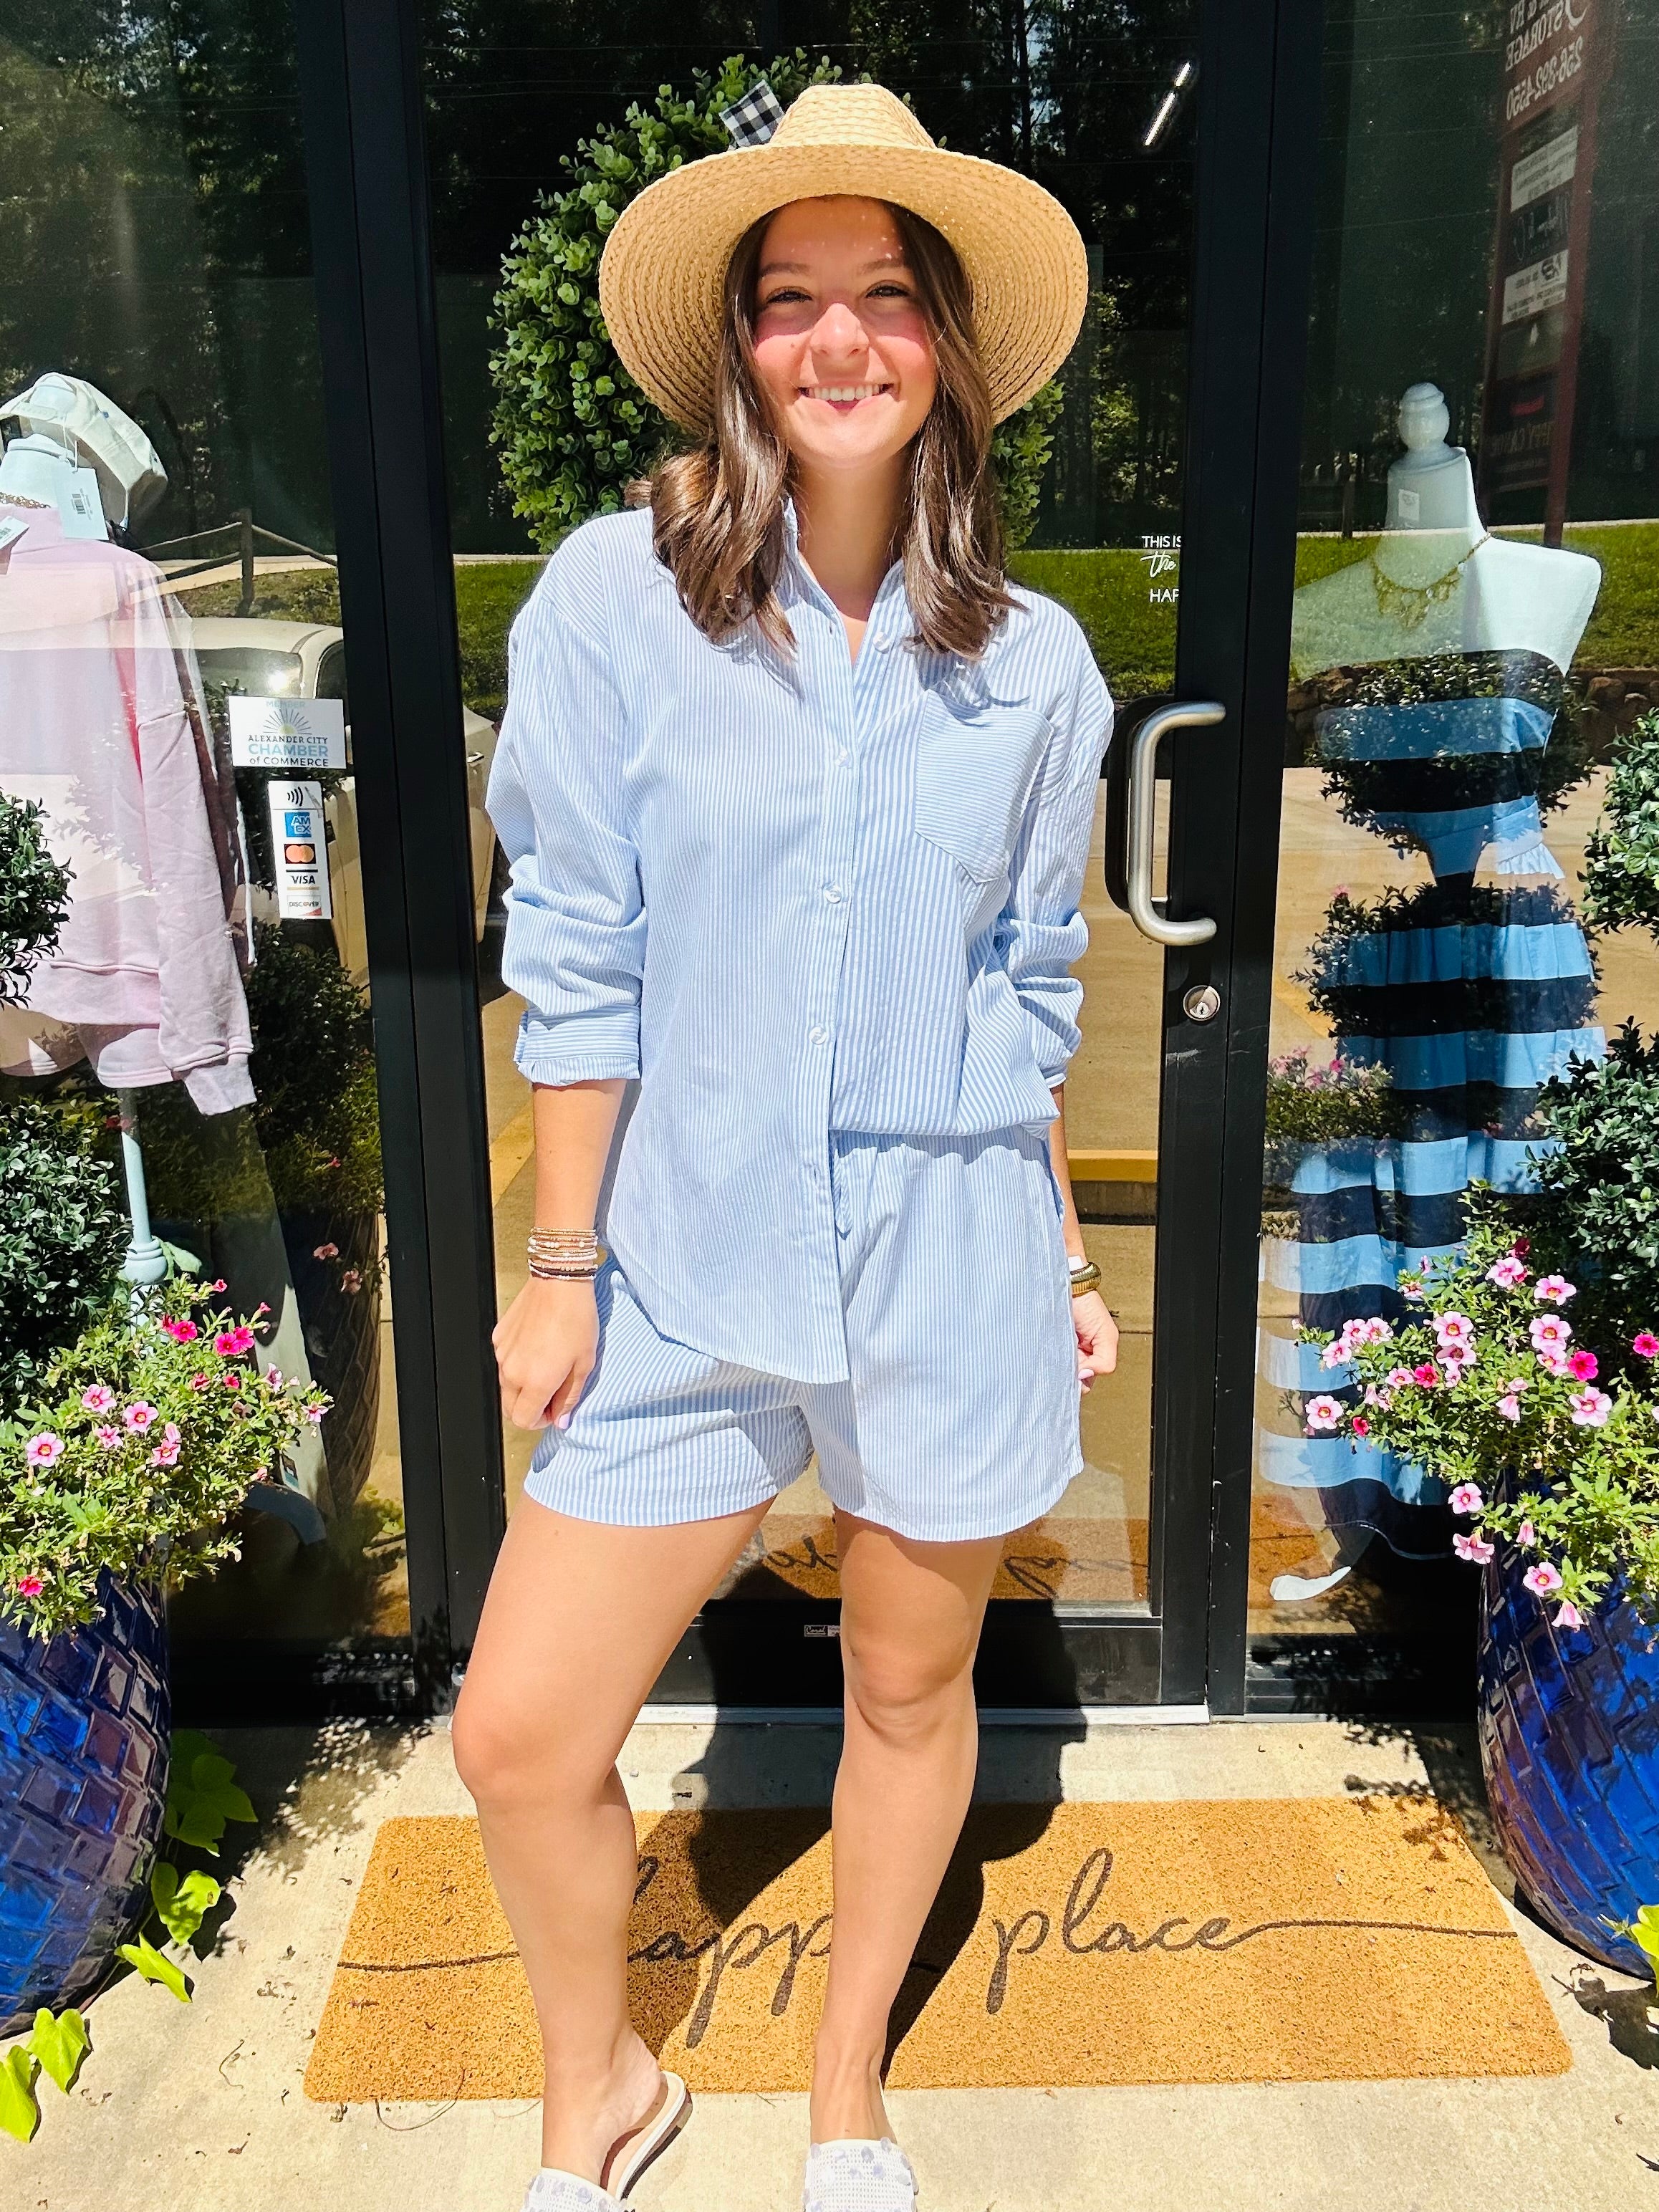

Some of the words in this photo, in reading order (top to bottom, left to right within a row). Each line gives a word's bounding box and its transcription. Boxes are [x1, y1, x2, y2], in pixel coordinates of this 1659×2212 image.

[1141, 535, 1170, 548] THIS
[1173, 535, 1181, 548] IS
[248, 734, 304, 744] ALEXANDER
[248, 743, 329, 757] CHAMBER
[264, 757, 330, 767] COMMERCE
[292, 816, 311, 825] AM
[291, 875, 316, 885] VISA
[627, 1855, 833, 2049] app
[986, 1847, 1236, 2015] place
